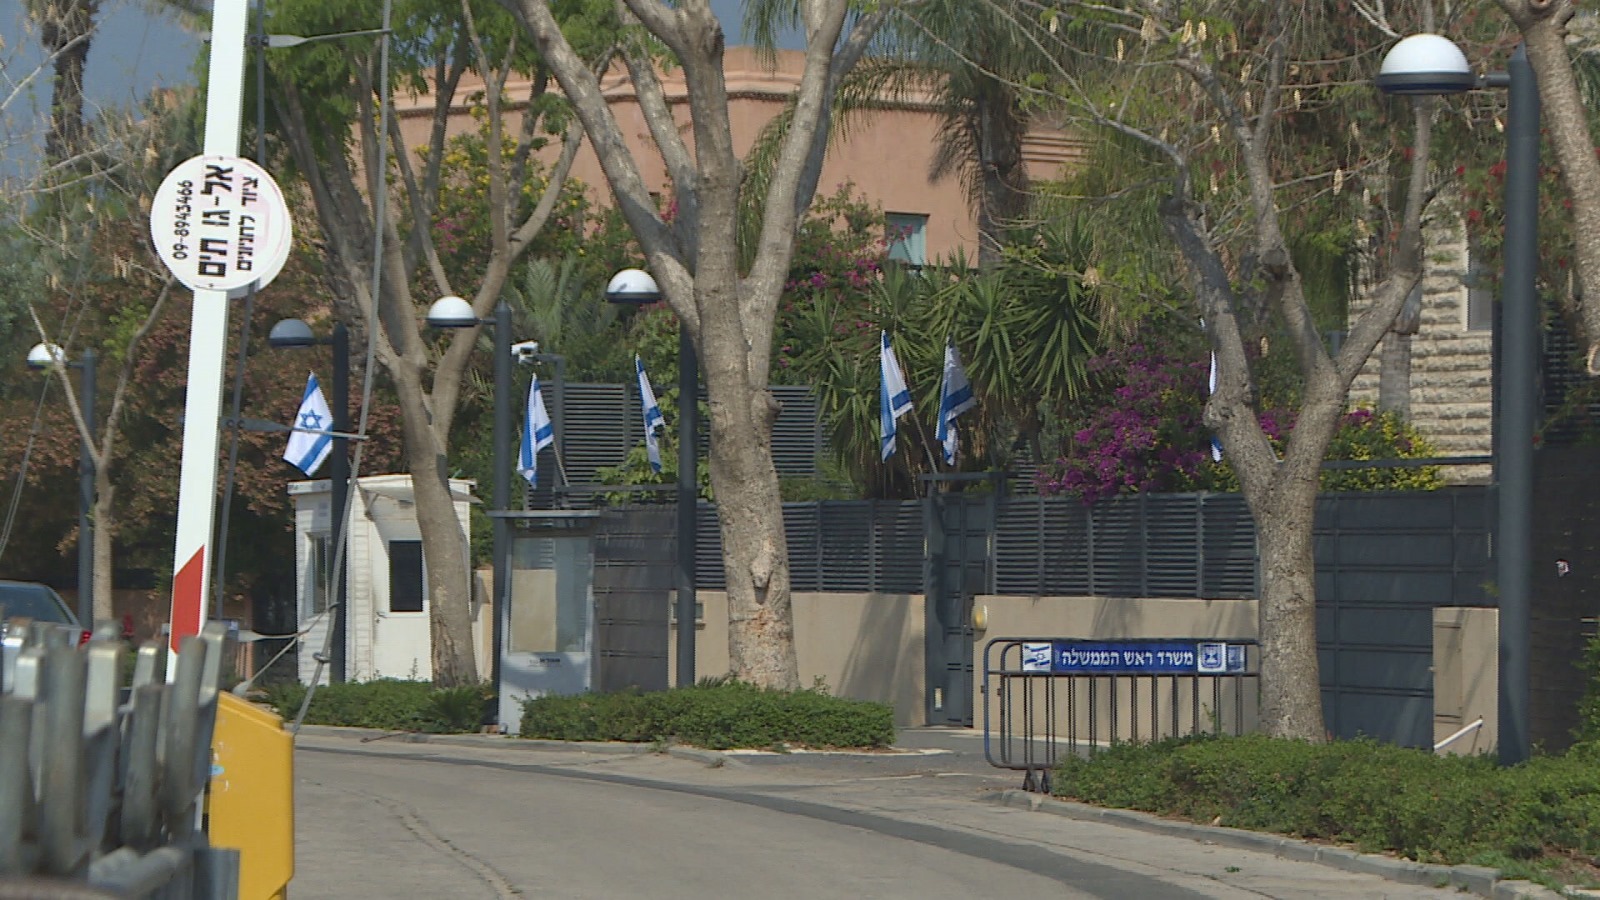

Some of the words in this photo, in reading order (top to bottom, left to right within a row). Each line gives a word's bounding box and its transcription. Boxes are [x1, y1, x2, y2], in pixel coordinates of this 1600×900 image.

[200, 164, 234, 227] אל-גו
[241, 176, 258, 206] ציוד
[172, 180, 193, 260] 09-8943466
[198, 238, 228, 277] תים
[237, 215, 255, 271] לחניונים
[1061, 647, 1120, 666] הממשלה
[1123, 650, 1153, 666] ראש
[1157, 650, 1194, 666] משרד
